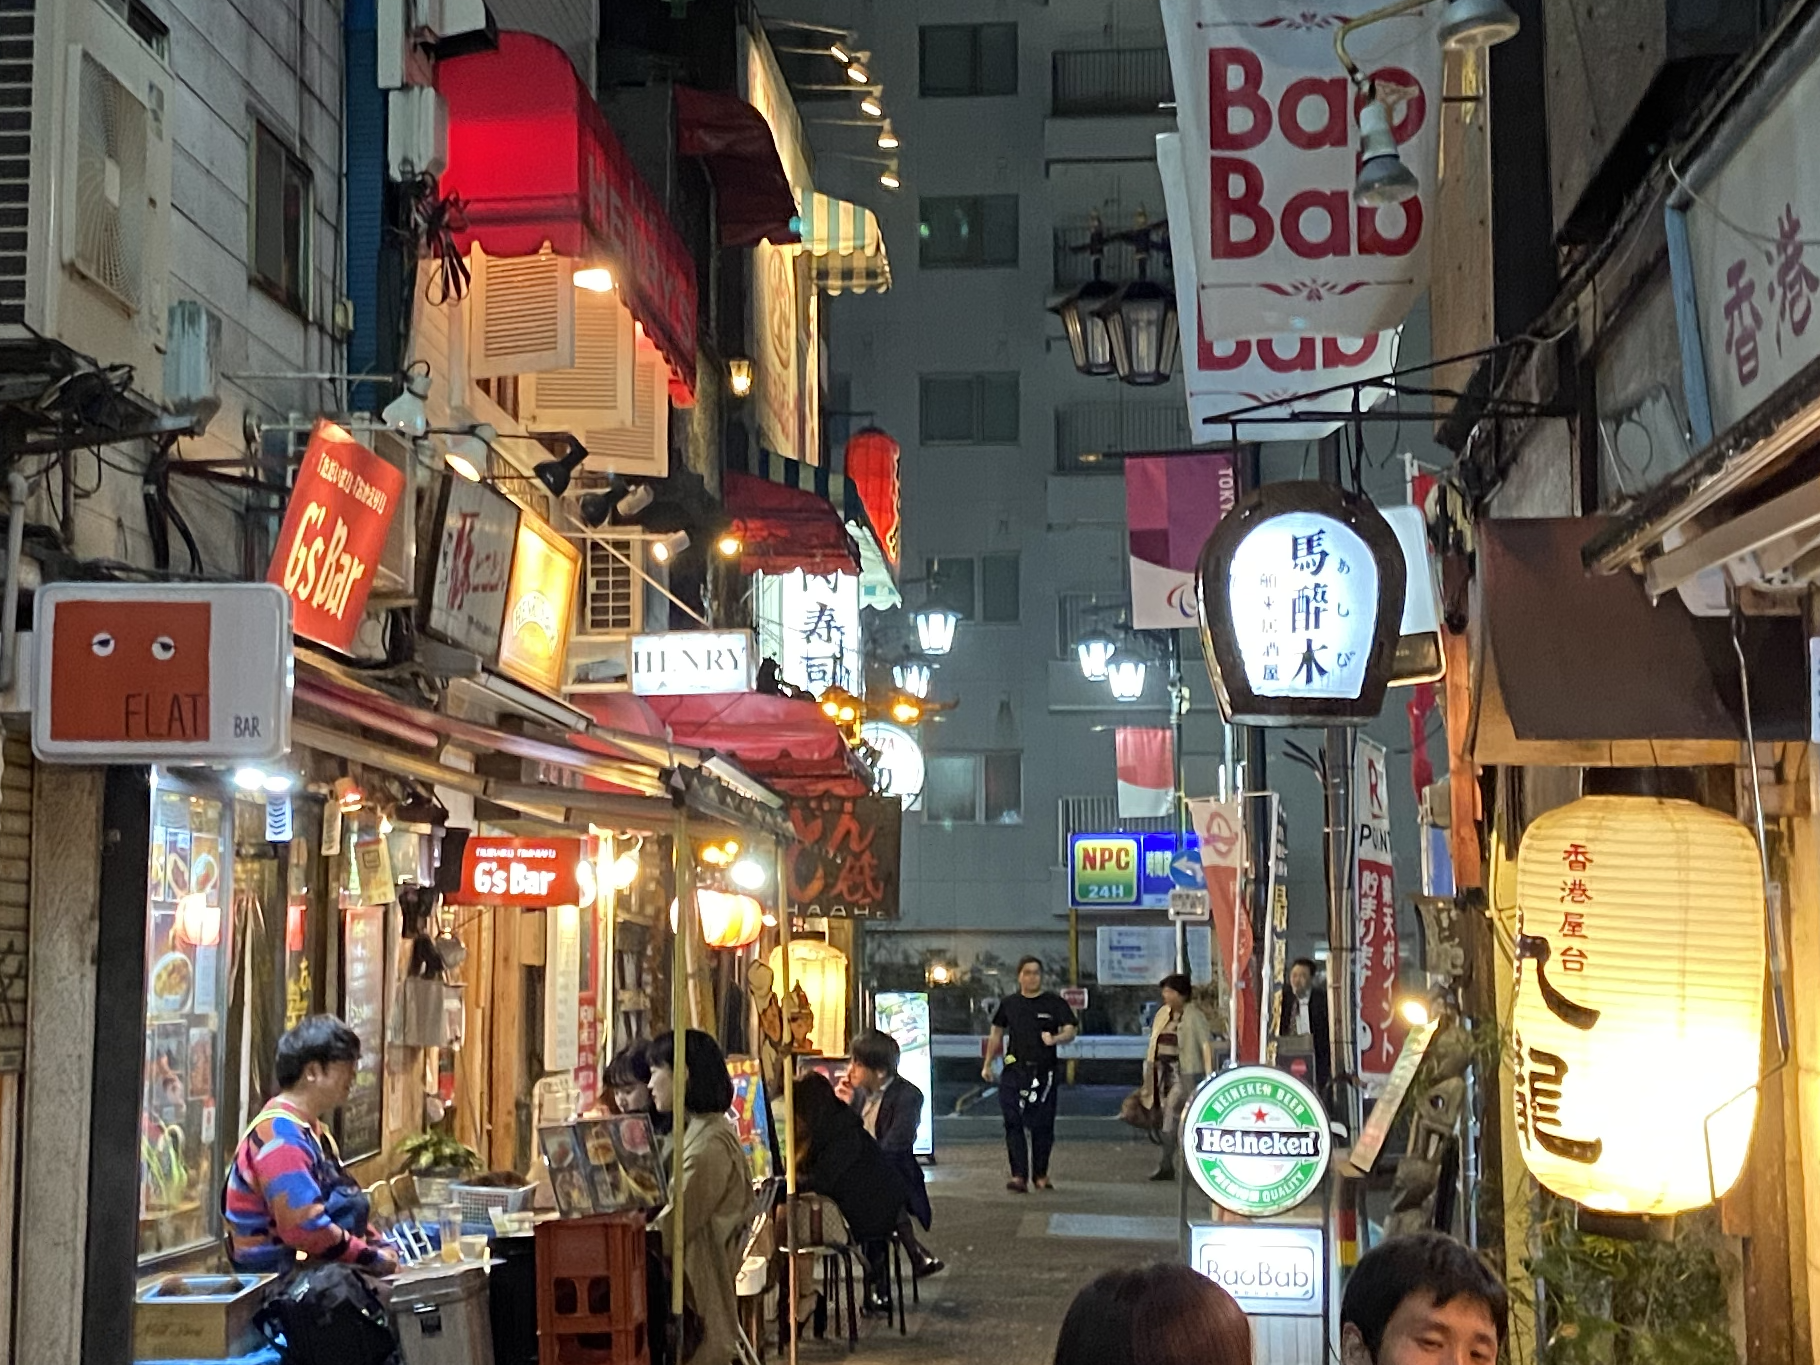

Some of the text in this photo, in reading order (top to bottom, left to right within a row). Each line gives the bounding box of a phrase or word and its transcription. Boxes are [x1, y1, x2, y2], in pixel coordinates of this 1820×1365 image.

[1210, 152, 1424, 260] Bab
[1218, 467, 1236, 520] TOKY
[283, 501, 327, 601] G's
[311, 515, 365, 621] Bar
[633, 648, 739, 674] HENRY
[124, 692, 204, 738] FLAT
[233, 715, 261, 739] BAR
[1081, 847, 1130, 872] NPC
[474, 861, 556, 896] G's Bar
[1088, 884, 1124, 899] 24H
[1558, 843, 1594, 973] 香港屋台
[1211, 1082, 1305, 1116] HEINEKEN BEER
[1201, 1128, 1316, 1155] Heineken
[1261, 1170, 1305, 1203] QUALITY
[1207, 1259, 1309, 1288] BaoBab
